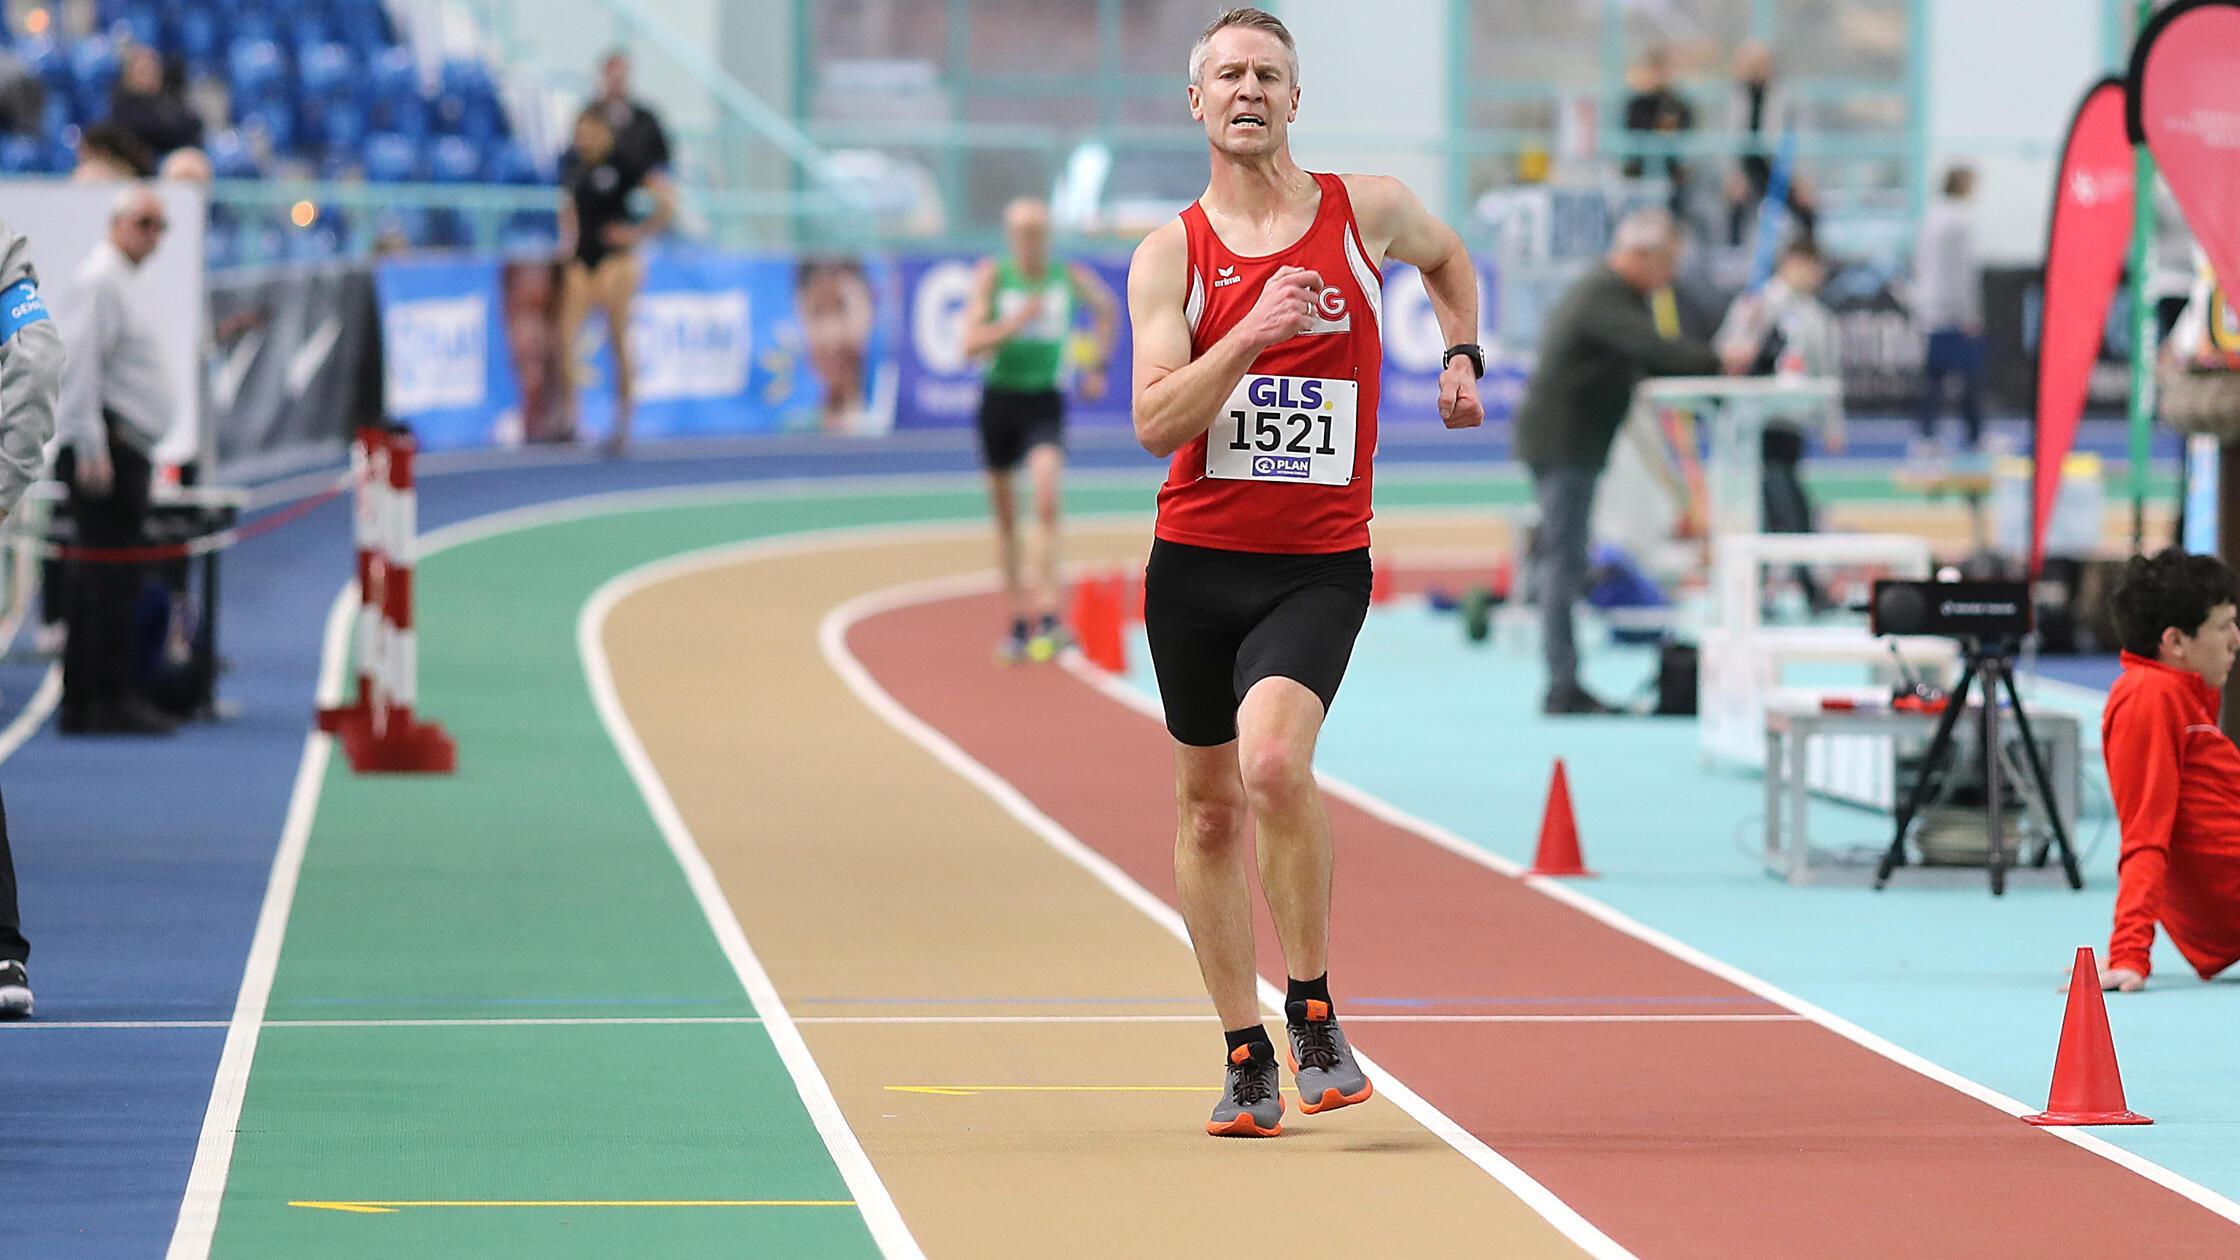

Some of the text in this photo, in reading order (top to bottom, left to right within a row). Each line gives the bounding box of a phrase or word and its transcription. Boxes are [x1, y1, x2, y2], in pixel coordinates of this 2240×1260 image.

[1214, 275, 1241, 287] erima
[1229, 410, 1336, 455] 1521
[1276, 459, 1309, 471] PLAN
